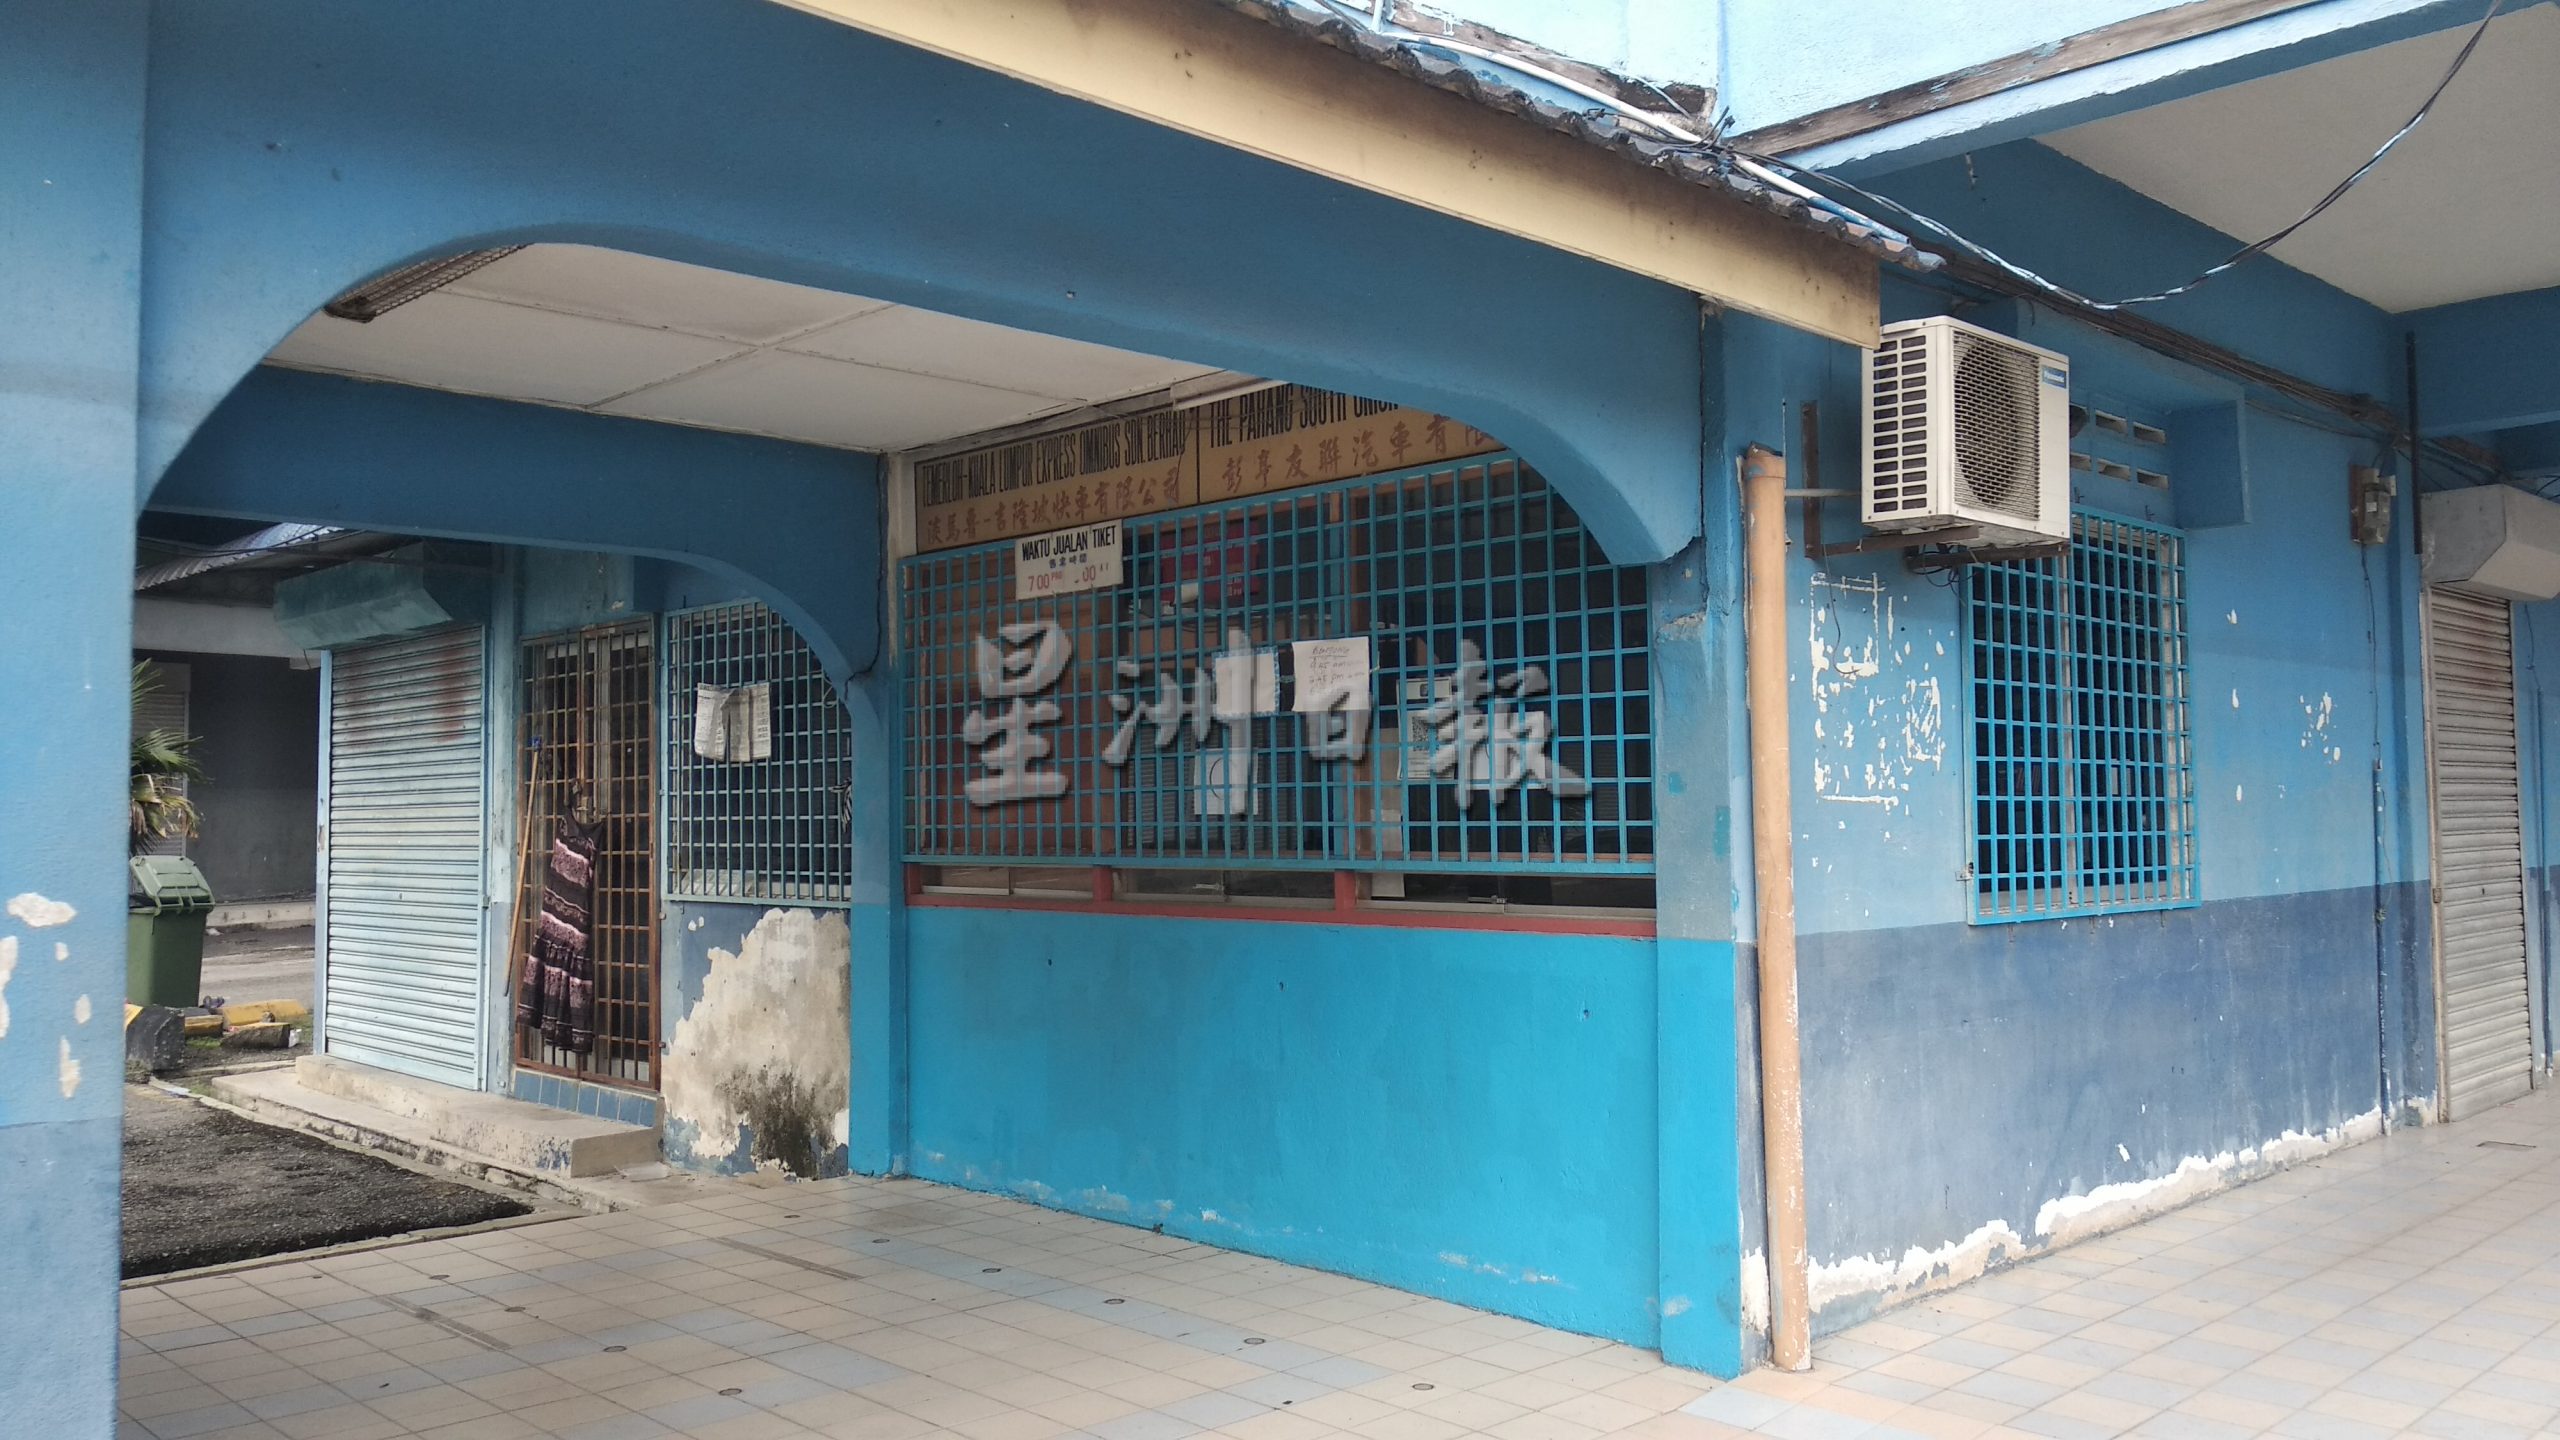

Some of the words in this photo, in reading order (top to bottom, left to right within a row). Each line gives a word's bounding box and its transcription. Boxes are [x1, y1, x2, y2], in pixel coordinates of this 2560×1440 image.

[1209, 398, 1233, 448] THE
[1239, 383, 1294, 442] PAHANG
[998, 441, 1033, 493] LUMPUR
[1036, 432, 1076, 485] EXPRESS
[1079, 422, 1121, 476] OMNIBUS
[1147, 409, 1187, 462] BERHAD
[1021, 538, 1050, 562] WAKTU
[1053, 530, 1088, 556] JUALAN
[1092, 525, 1116, 549] TIKET
